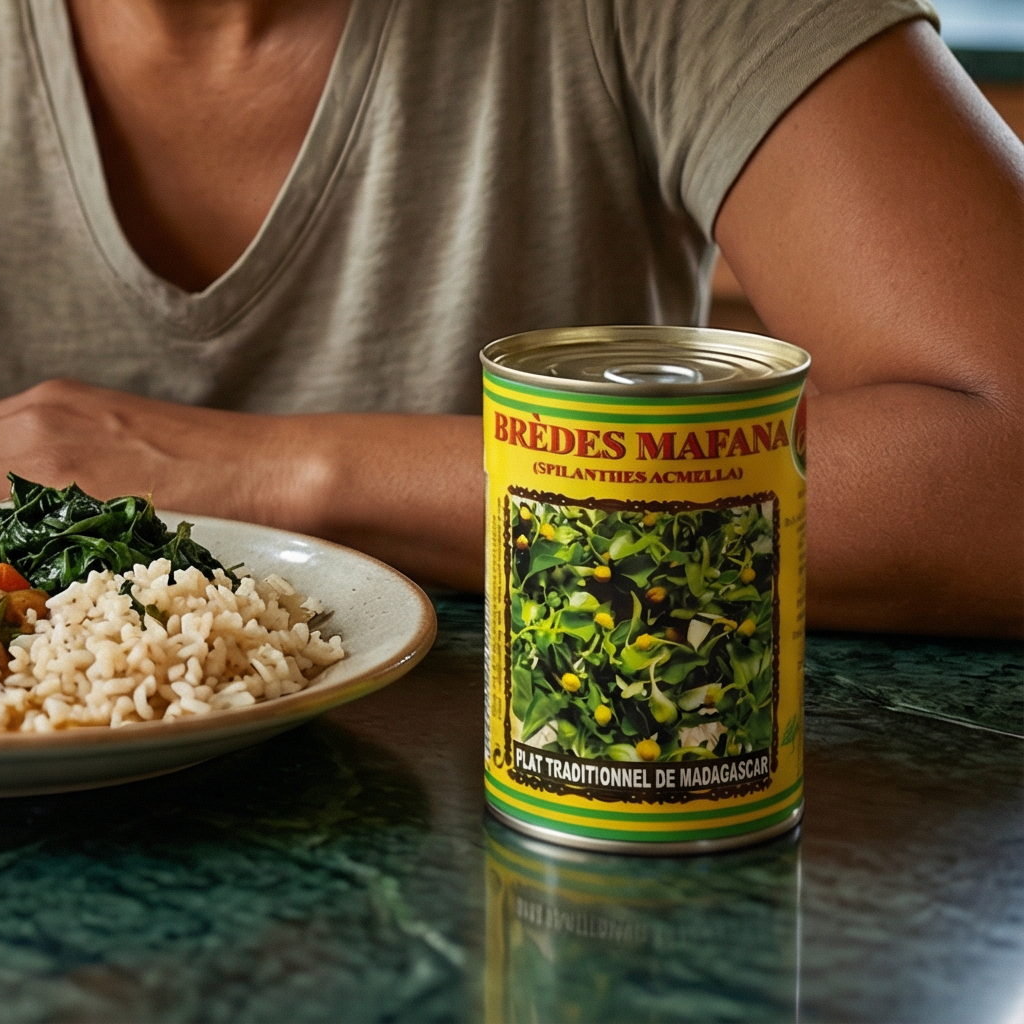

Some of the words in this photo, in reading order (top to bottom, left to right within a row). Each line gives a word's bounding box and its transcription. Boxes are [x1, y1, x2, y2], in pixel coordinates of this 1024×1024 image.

[494, 411, 626, 461] BRÈDES
[635, 419, 789, 460] MAFANA
[515, 747, 543, 774] PLAT
[545, 757, 652, 788] TRADITIONNEL
[655, 769, 676, 788] DE
[679, 754, 769, 788] MADAGASCAR
